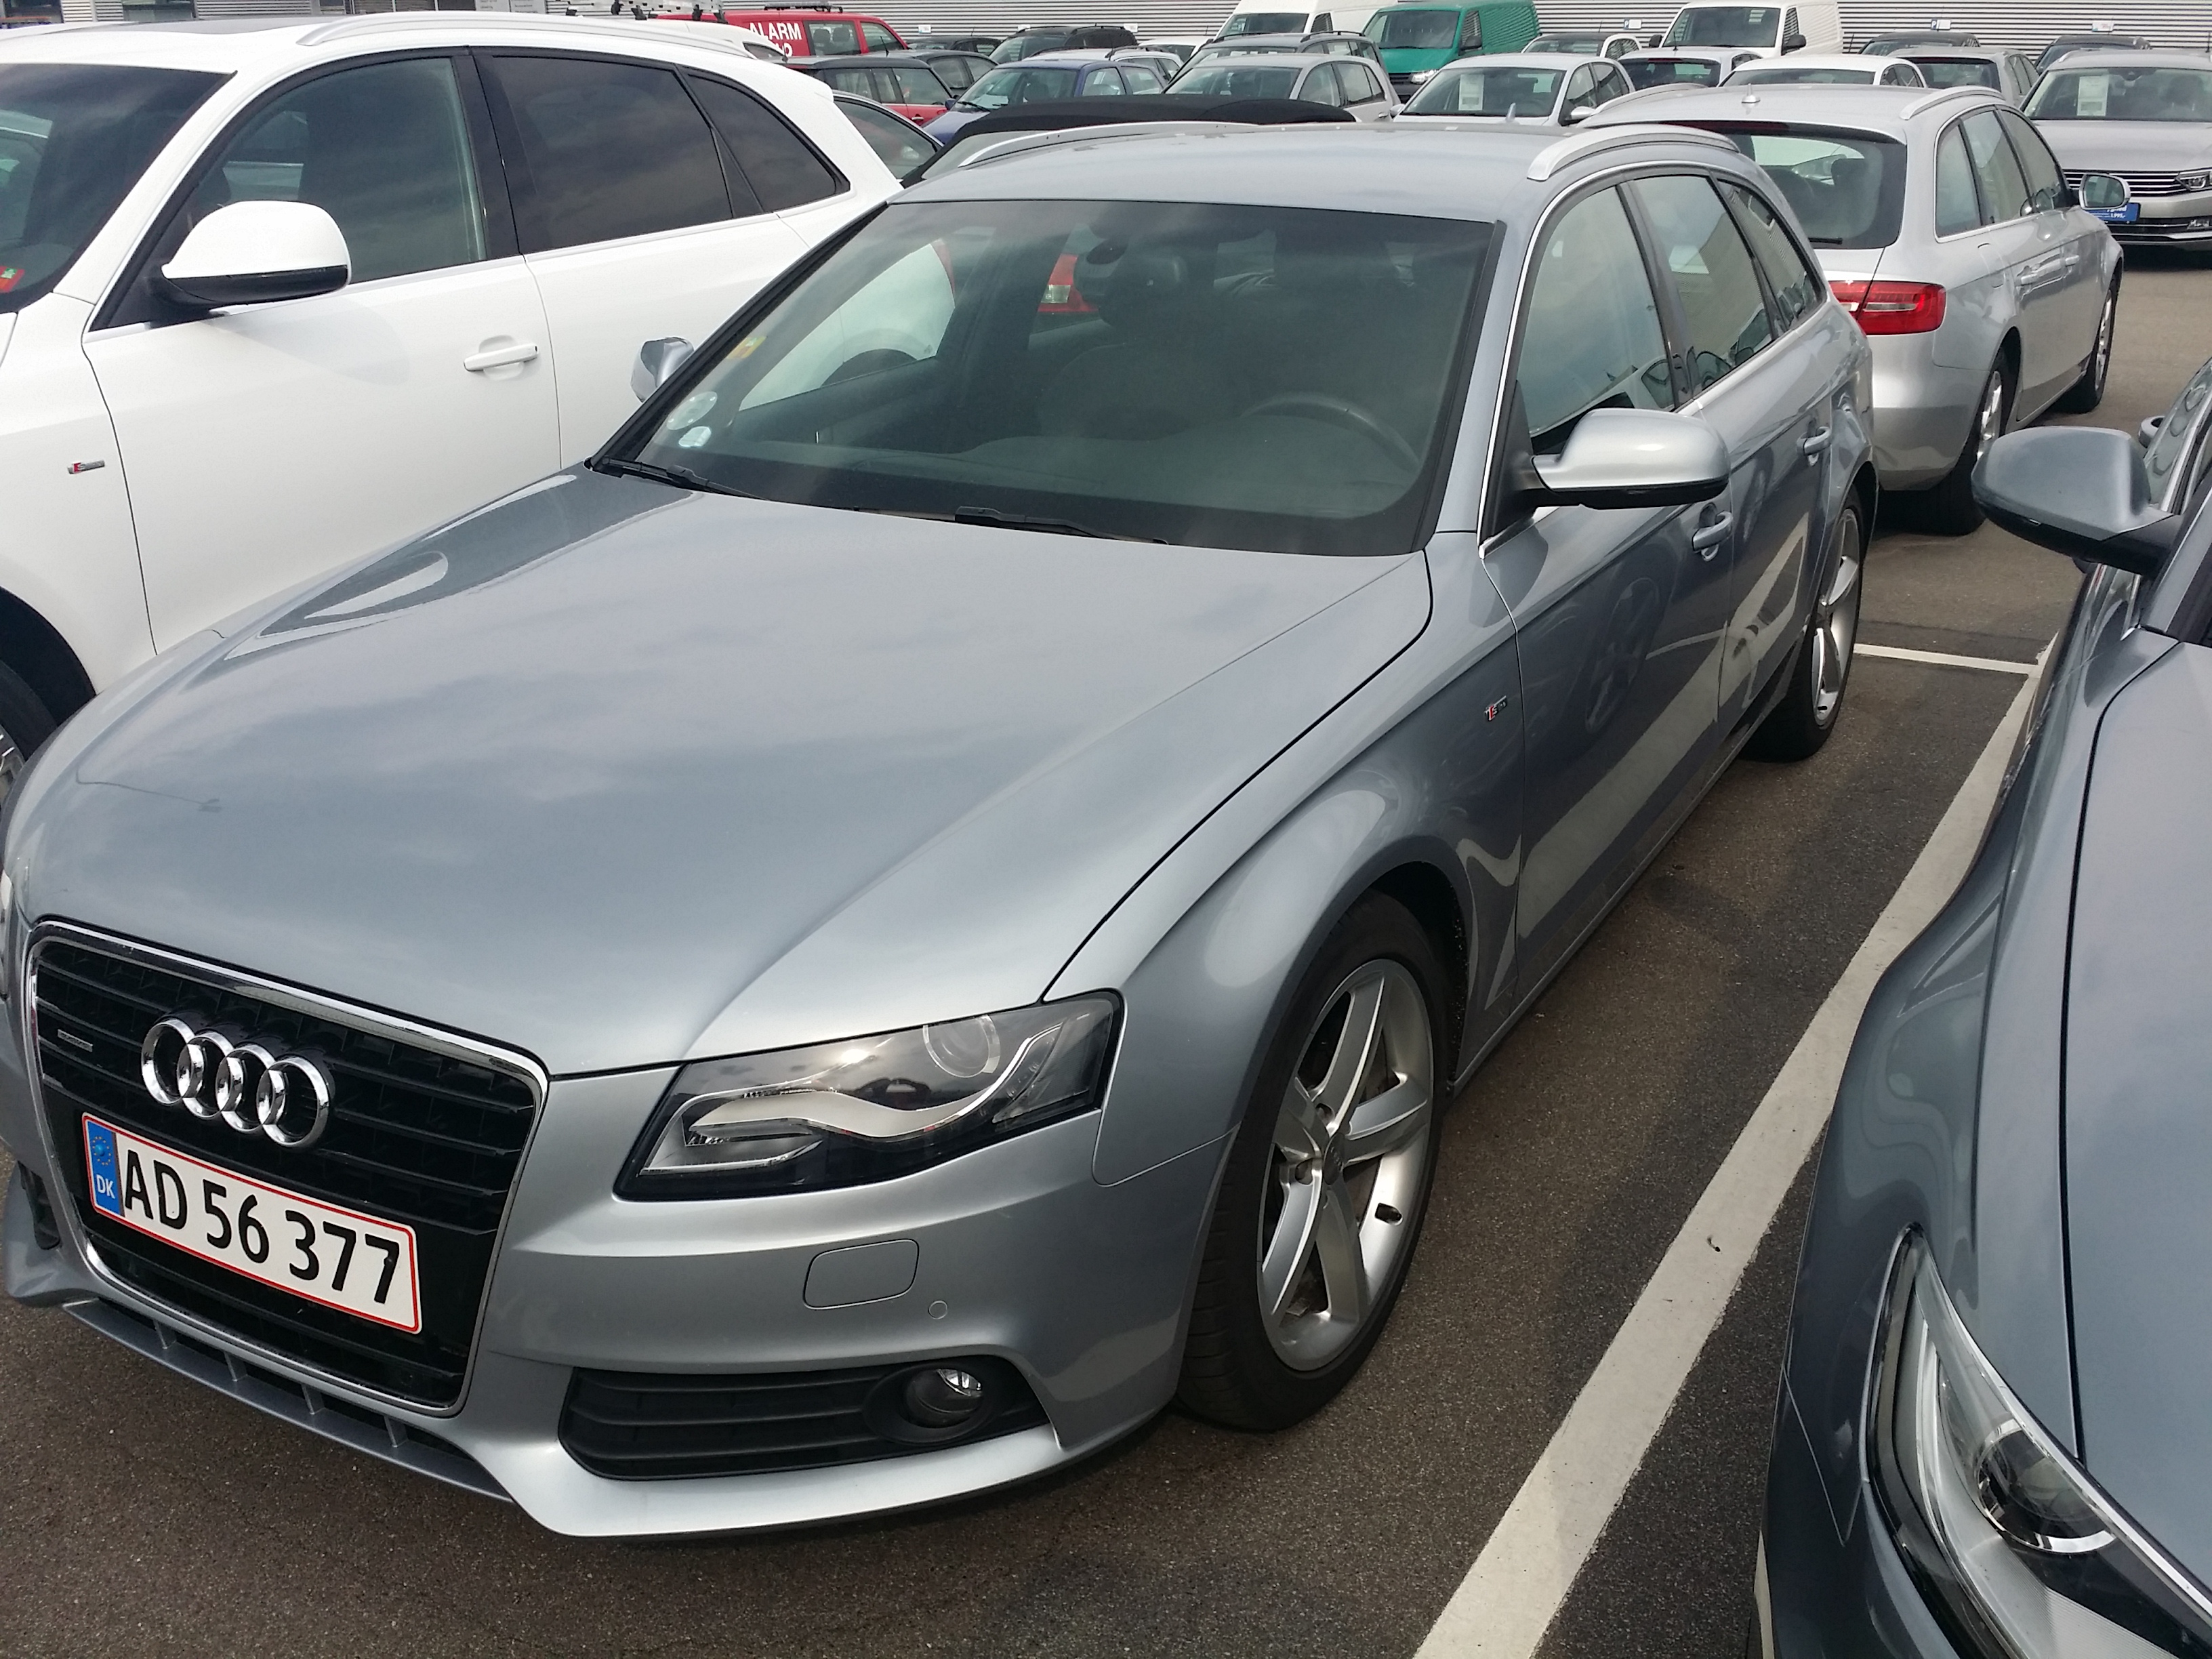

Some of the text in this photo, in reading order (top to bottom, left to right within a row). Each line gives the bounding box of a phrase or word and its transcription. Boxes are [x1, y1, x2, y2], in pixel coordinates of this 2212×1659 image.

[750, 22, 802, 40] ALARM
[96, 1174, 116, 1200] DK
[125, 1149, 400, 1305] AD 56 377
